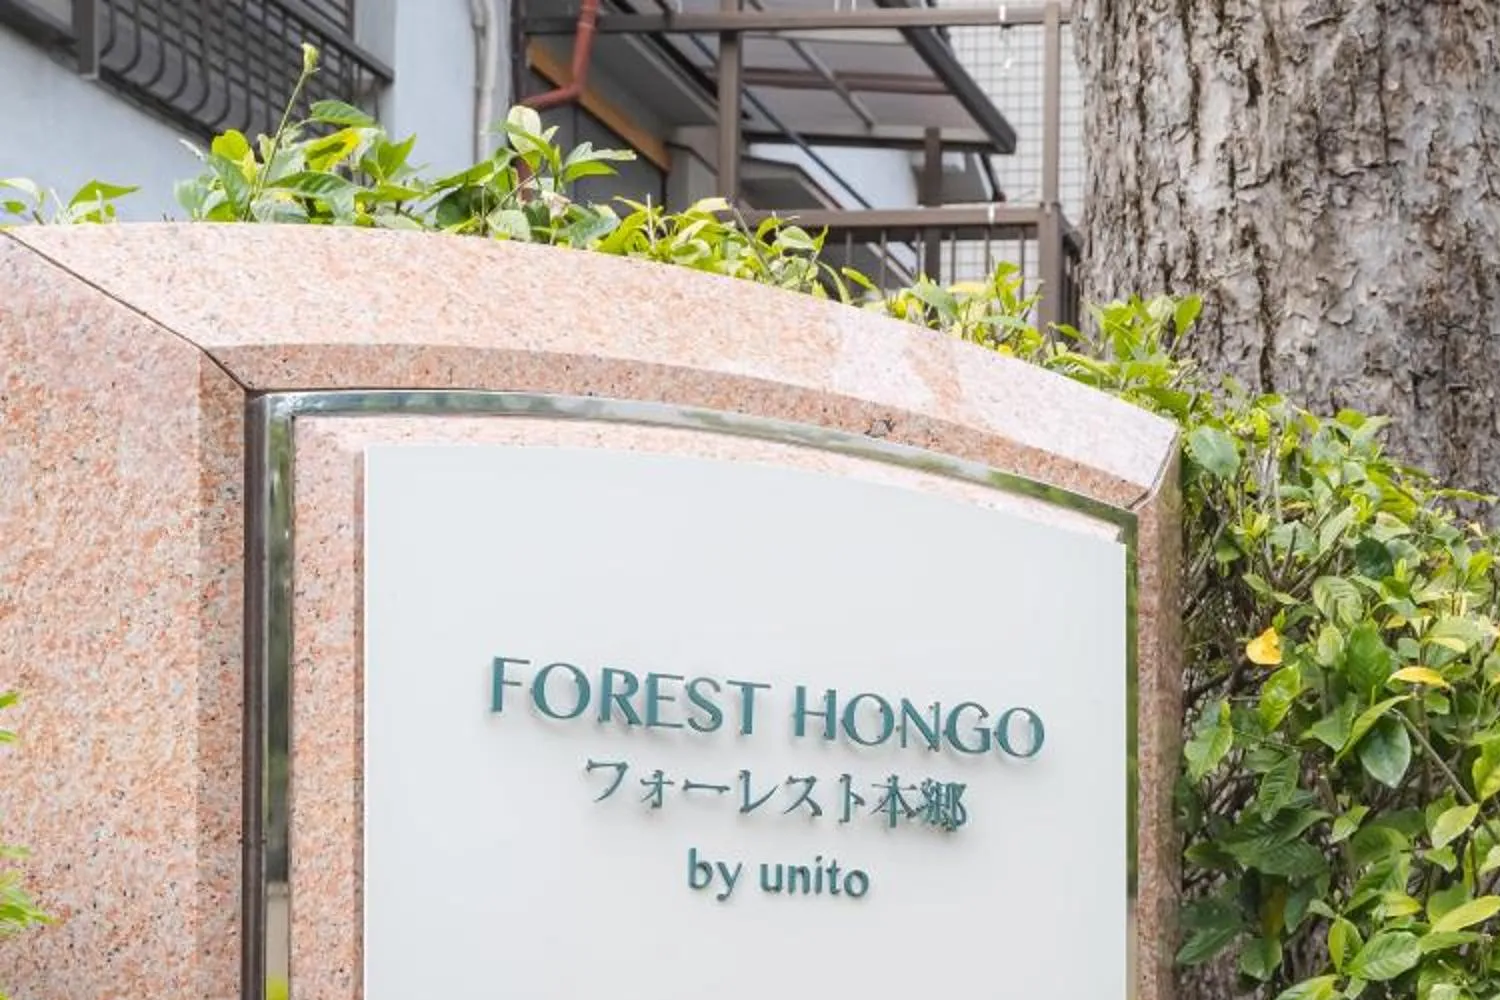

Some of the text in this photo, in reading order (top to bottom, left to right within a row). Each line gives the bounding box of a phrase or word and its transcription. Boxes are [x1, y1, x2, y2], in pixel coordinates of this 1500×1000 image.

[488, 656, 1045, 758] FOREST HONGO
[585, 758, 967, 832] フォーレスト本郷
[687, 847, 870, 901] by unito
